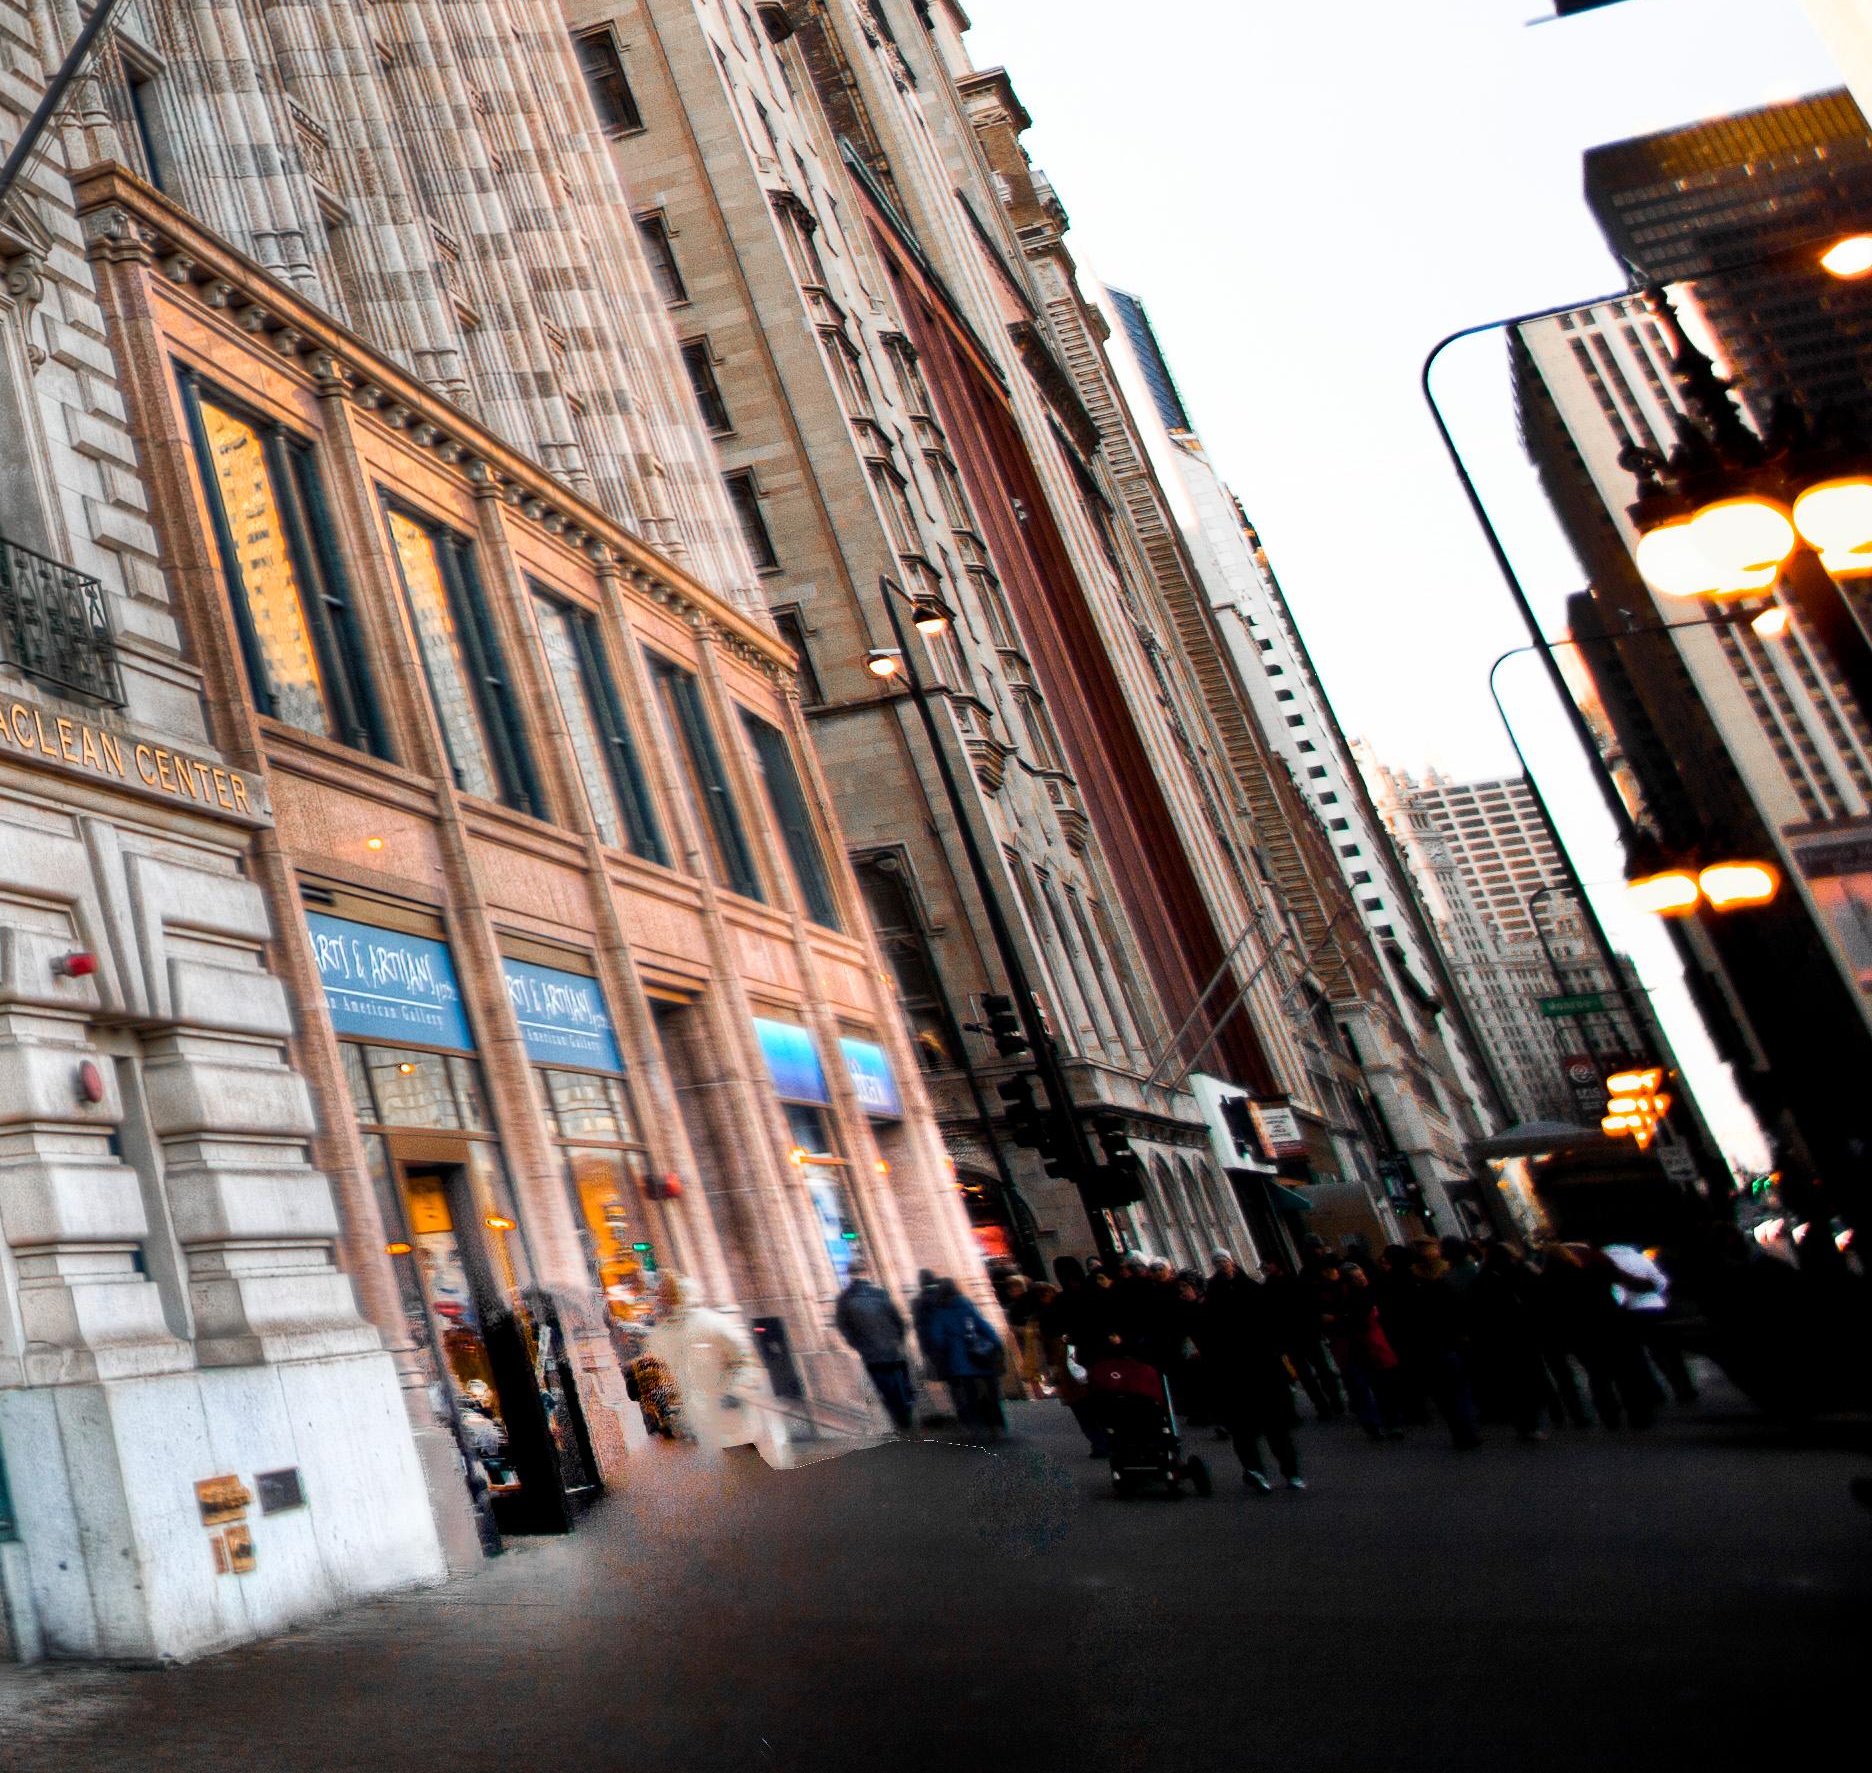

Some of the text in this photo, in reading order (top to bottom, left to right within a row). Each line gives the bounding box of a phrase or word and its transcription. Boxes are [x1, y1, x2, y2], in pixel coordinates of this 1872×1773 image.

[134, 744, 252, 815] CENTER
[344, 995, 396, 1019] American
[402, 1006, 444, 1031] Gallery
